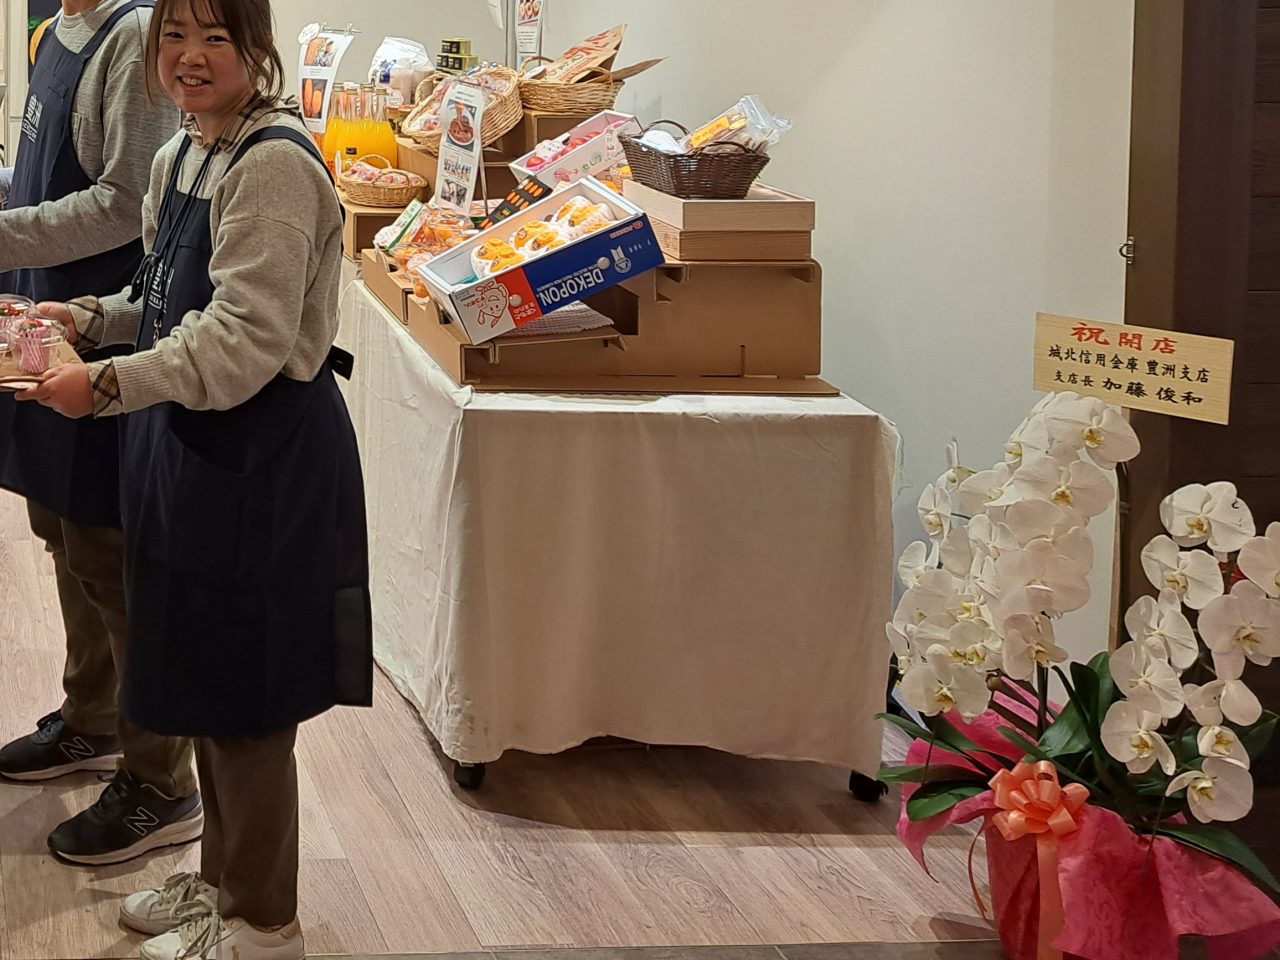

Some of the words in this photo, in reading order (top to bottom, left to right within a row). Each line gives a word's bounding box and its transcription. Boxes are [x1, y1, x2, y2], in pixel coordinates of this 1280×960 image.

[539, 268, 604, 307] DEKOPON
[1070, 322, 1179, 355] 祝開店
[1048, 345, 1140, 374] 城北信用金庫
[1145, 359, 1211, 384] 豊洲支店
[1054, 369, 1095, 388] 支店長
[1102, 377, 1148, 399] 加藤
[1155, 386, 1205, 407] 俊和
